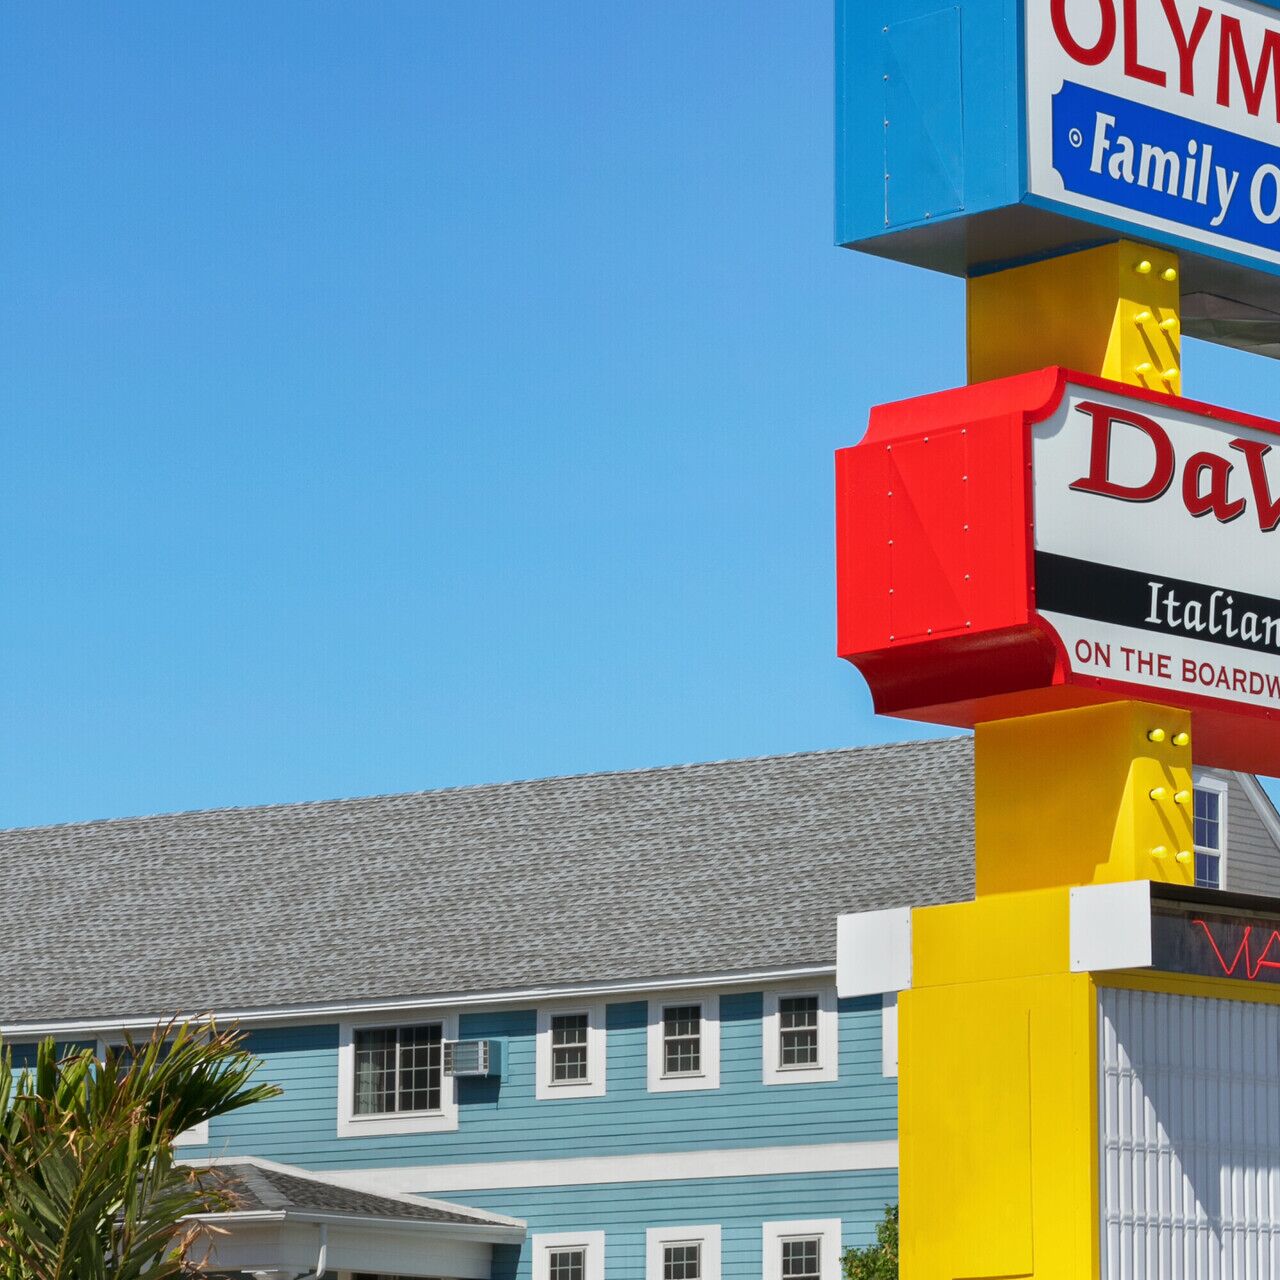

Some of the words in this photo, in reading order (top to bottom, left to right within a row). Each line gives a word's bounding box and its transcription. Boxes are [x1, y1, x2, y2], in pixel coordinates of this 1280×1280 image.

[1090, 111, 1240, 226] Family
[1075, 639, 1112, 668] ON
[1120, 646, 1171, 679] THE
